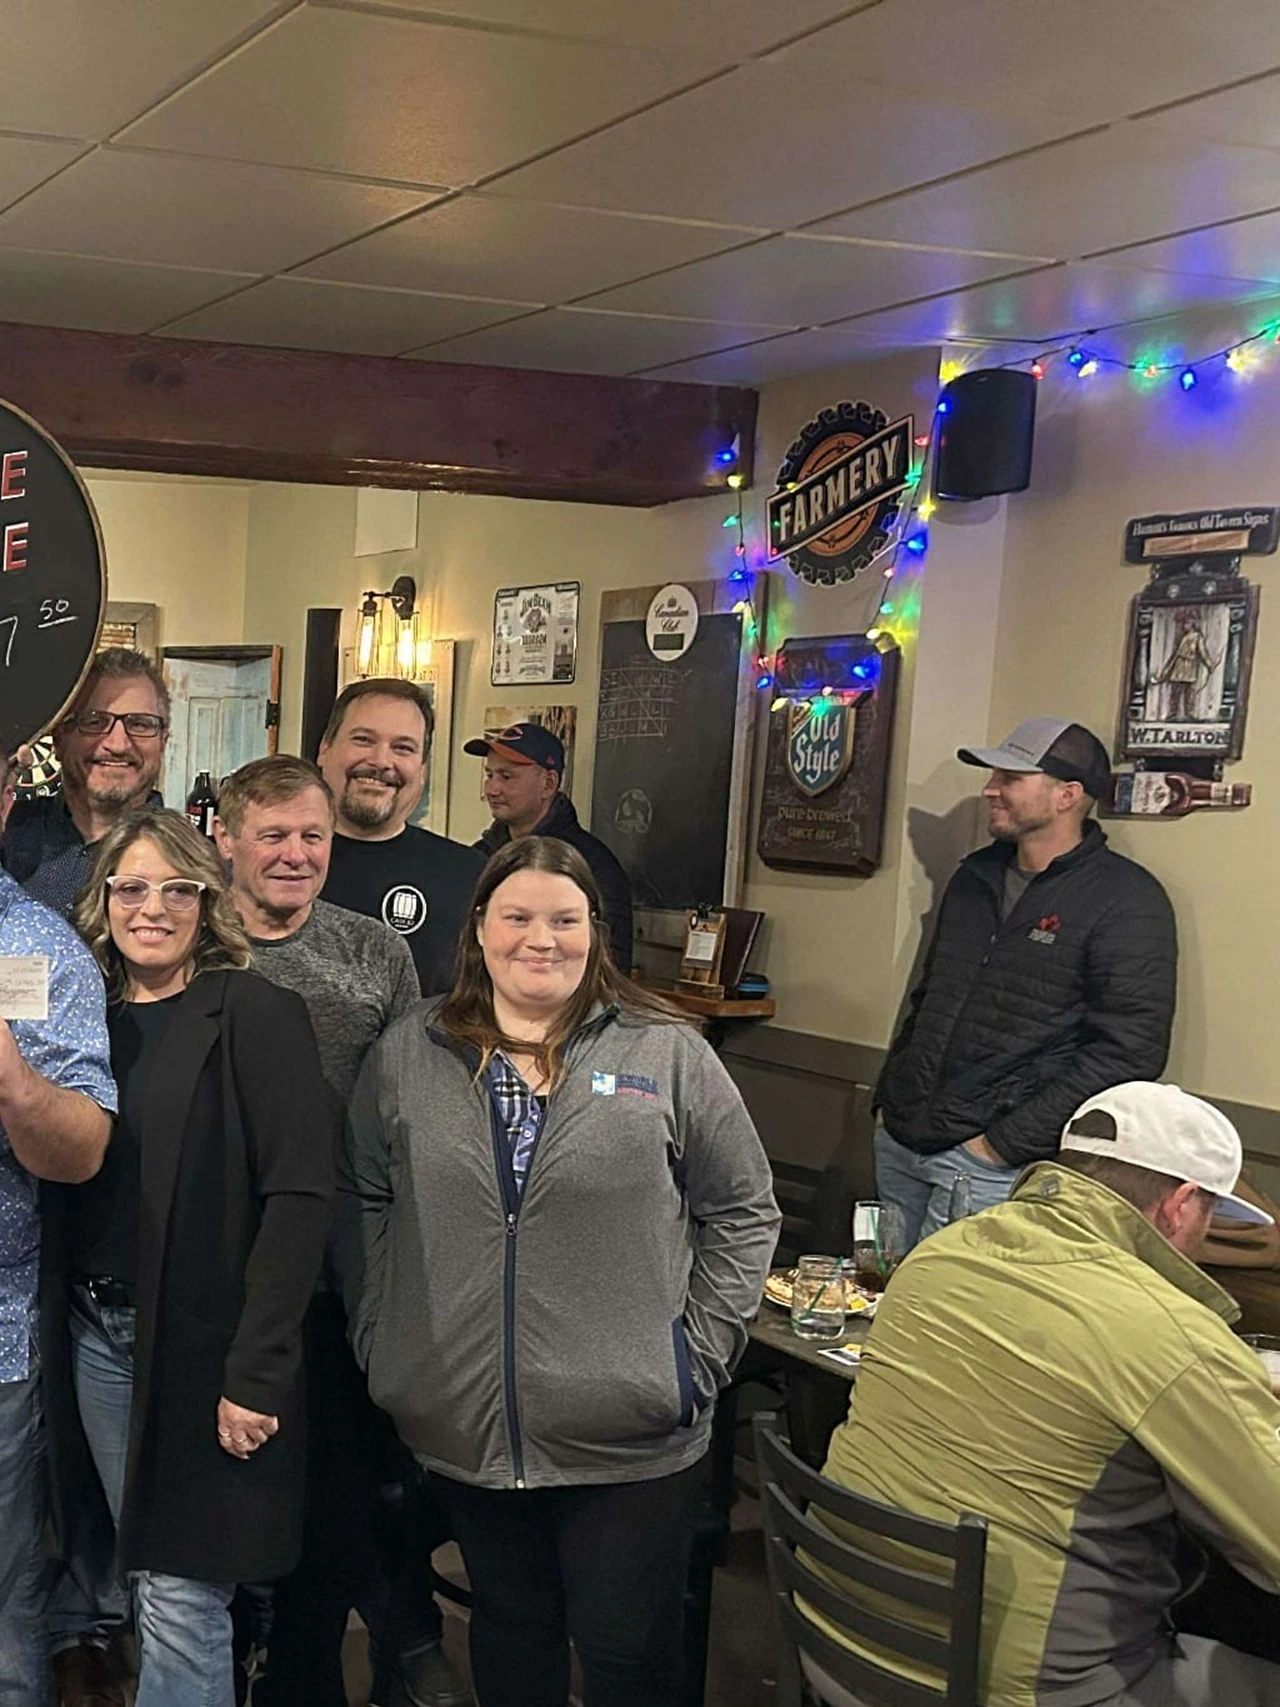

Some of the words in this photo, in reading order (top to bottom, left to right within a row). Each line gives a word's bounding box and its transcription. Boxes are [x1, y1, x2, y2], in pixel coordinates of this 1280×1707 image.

[778, 433, 901, 542] FARMERY
[39, 598, 70, 620] 50
[653, 603, 690, 618] Canadian
[810, 712, 841, 742] Old
[793, 732, 840, 784] Style
